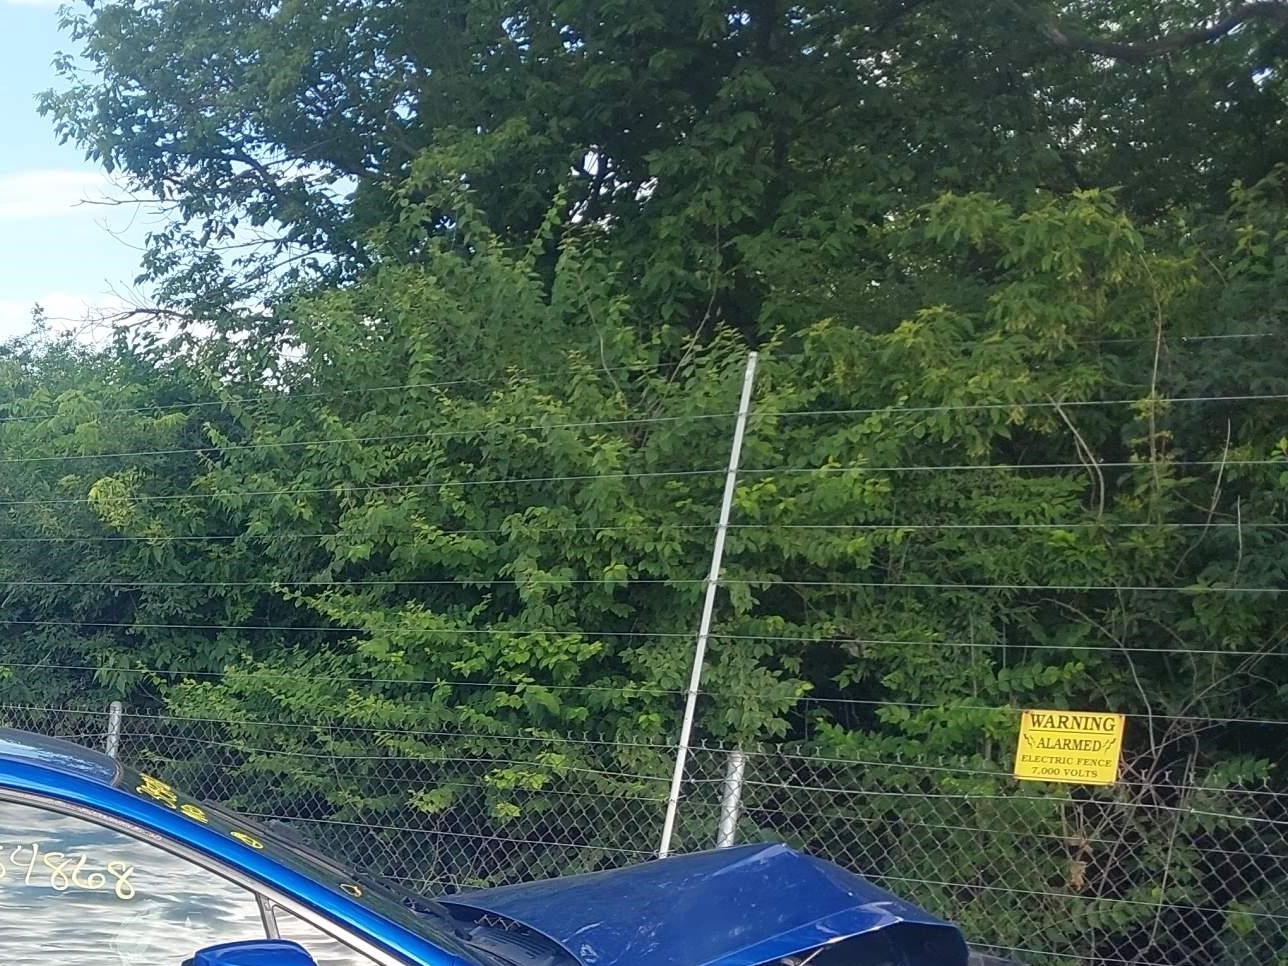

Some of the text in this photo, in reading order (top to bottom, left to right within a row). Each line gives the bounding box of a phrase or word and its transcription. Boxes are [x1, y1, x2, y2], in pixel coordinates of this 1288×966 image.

[1031, 714, 1116, 732] WARNING
[1036, 738, 1102, 752] ALARMED
[1021, 754, 1112, 767] ELECTRIC FENCE
[1064, 767, 1098, 778] VOLTS
